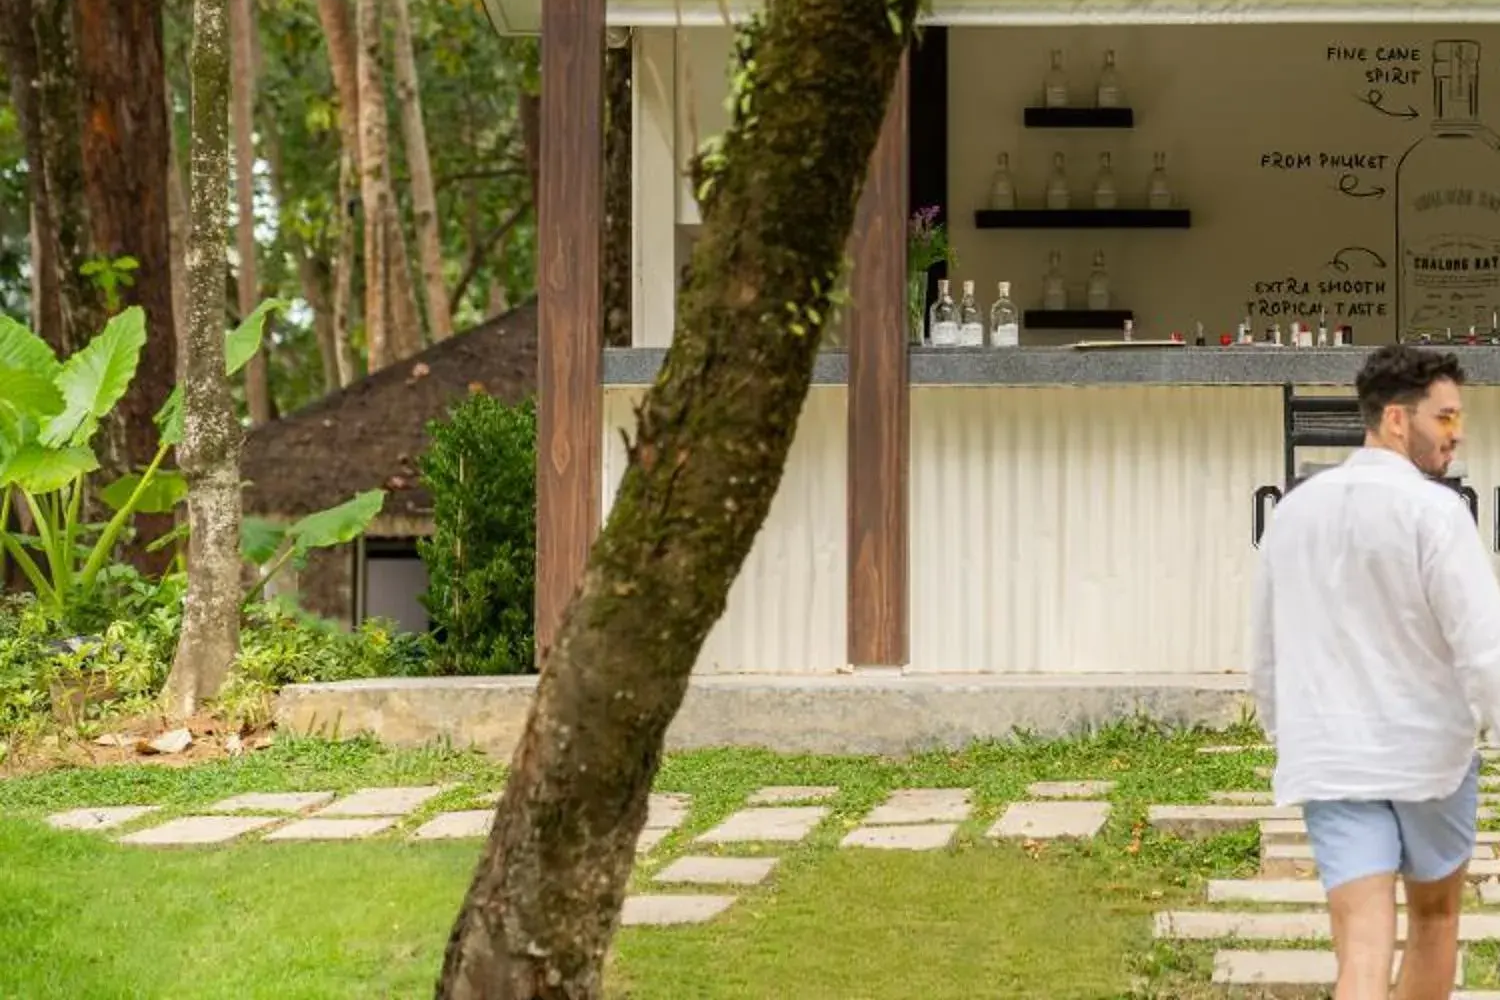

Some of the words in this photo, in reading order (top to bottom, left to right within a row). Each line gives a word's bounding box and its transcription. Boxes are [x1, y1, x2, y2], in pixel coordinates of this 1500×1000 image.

[1327, 47, 1367, 60] FINE
[1375, 47, 1421, 61] CANE
[1365, 67, 1421, 84] SPIRIT
[1261, 152, 1311, 168] FROM
[1319, 153, 1388, 169] PHUKET
[1255, 277, 1309, 295] EXTRA
[1317, 280, 1386, 295] SMOOTH
[1247, 300, 1328, 317] TROPICAL
[1336, 302, 1386, 317] TASTE
